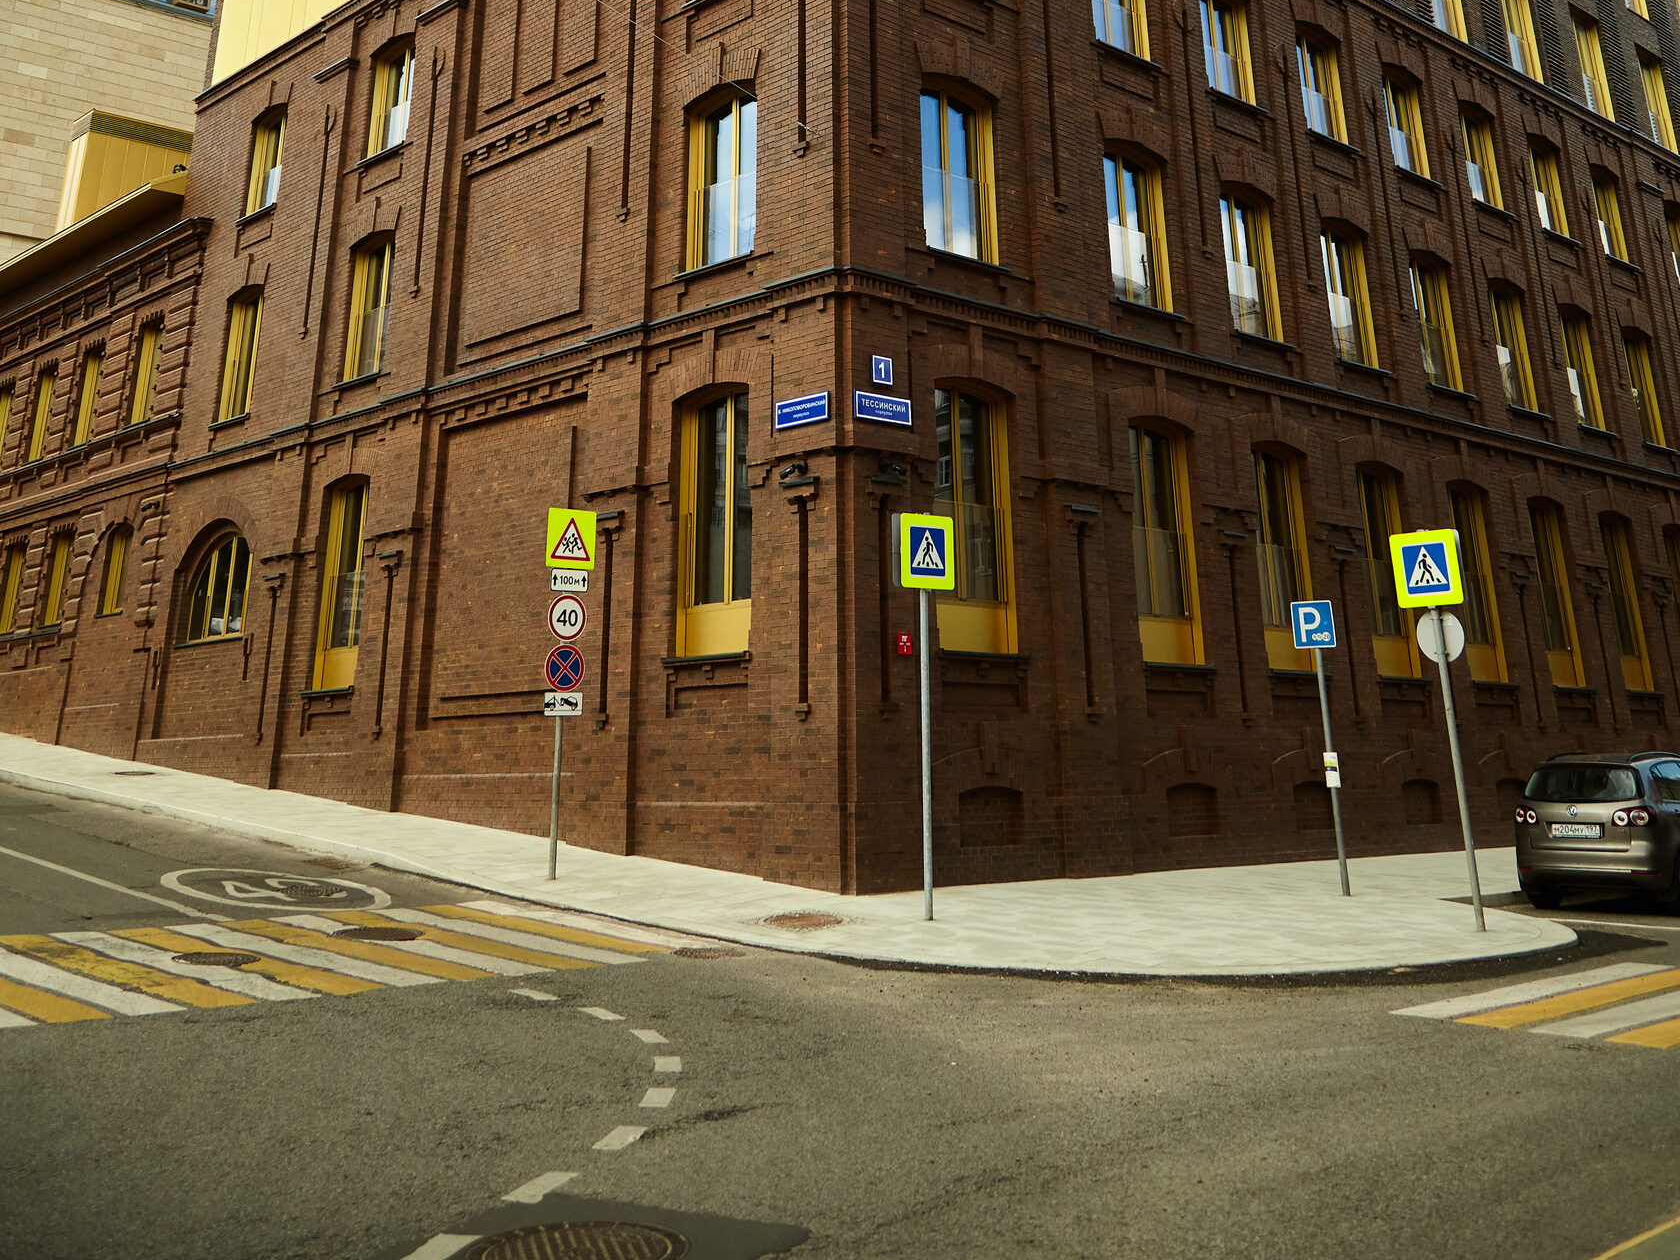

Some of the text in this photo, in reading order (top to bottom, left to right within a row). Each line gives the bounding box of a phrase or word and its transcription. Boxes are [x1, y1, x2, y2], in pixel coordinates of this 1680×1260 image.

[878, 361, 885, 379] 1
[861, 398, 906, 413] ТЕССИНСКИЙ
[556, 608, 578, 628] 40
[1298, 606, 1321, 643] P
